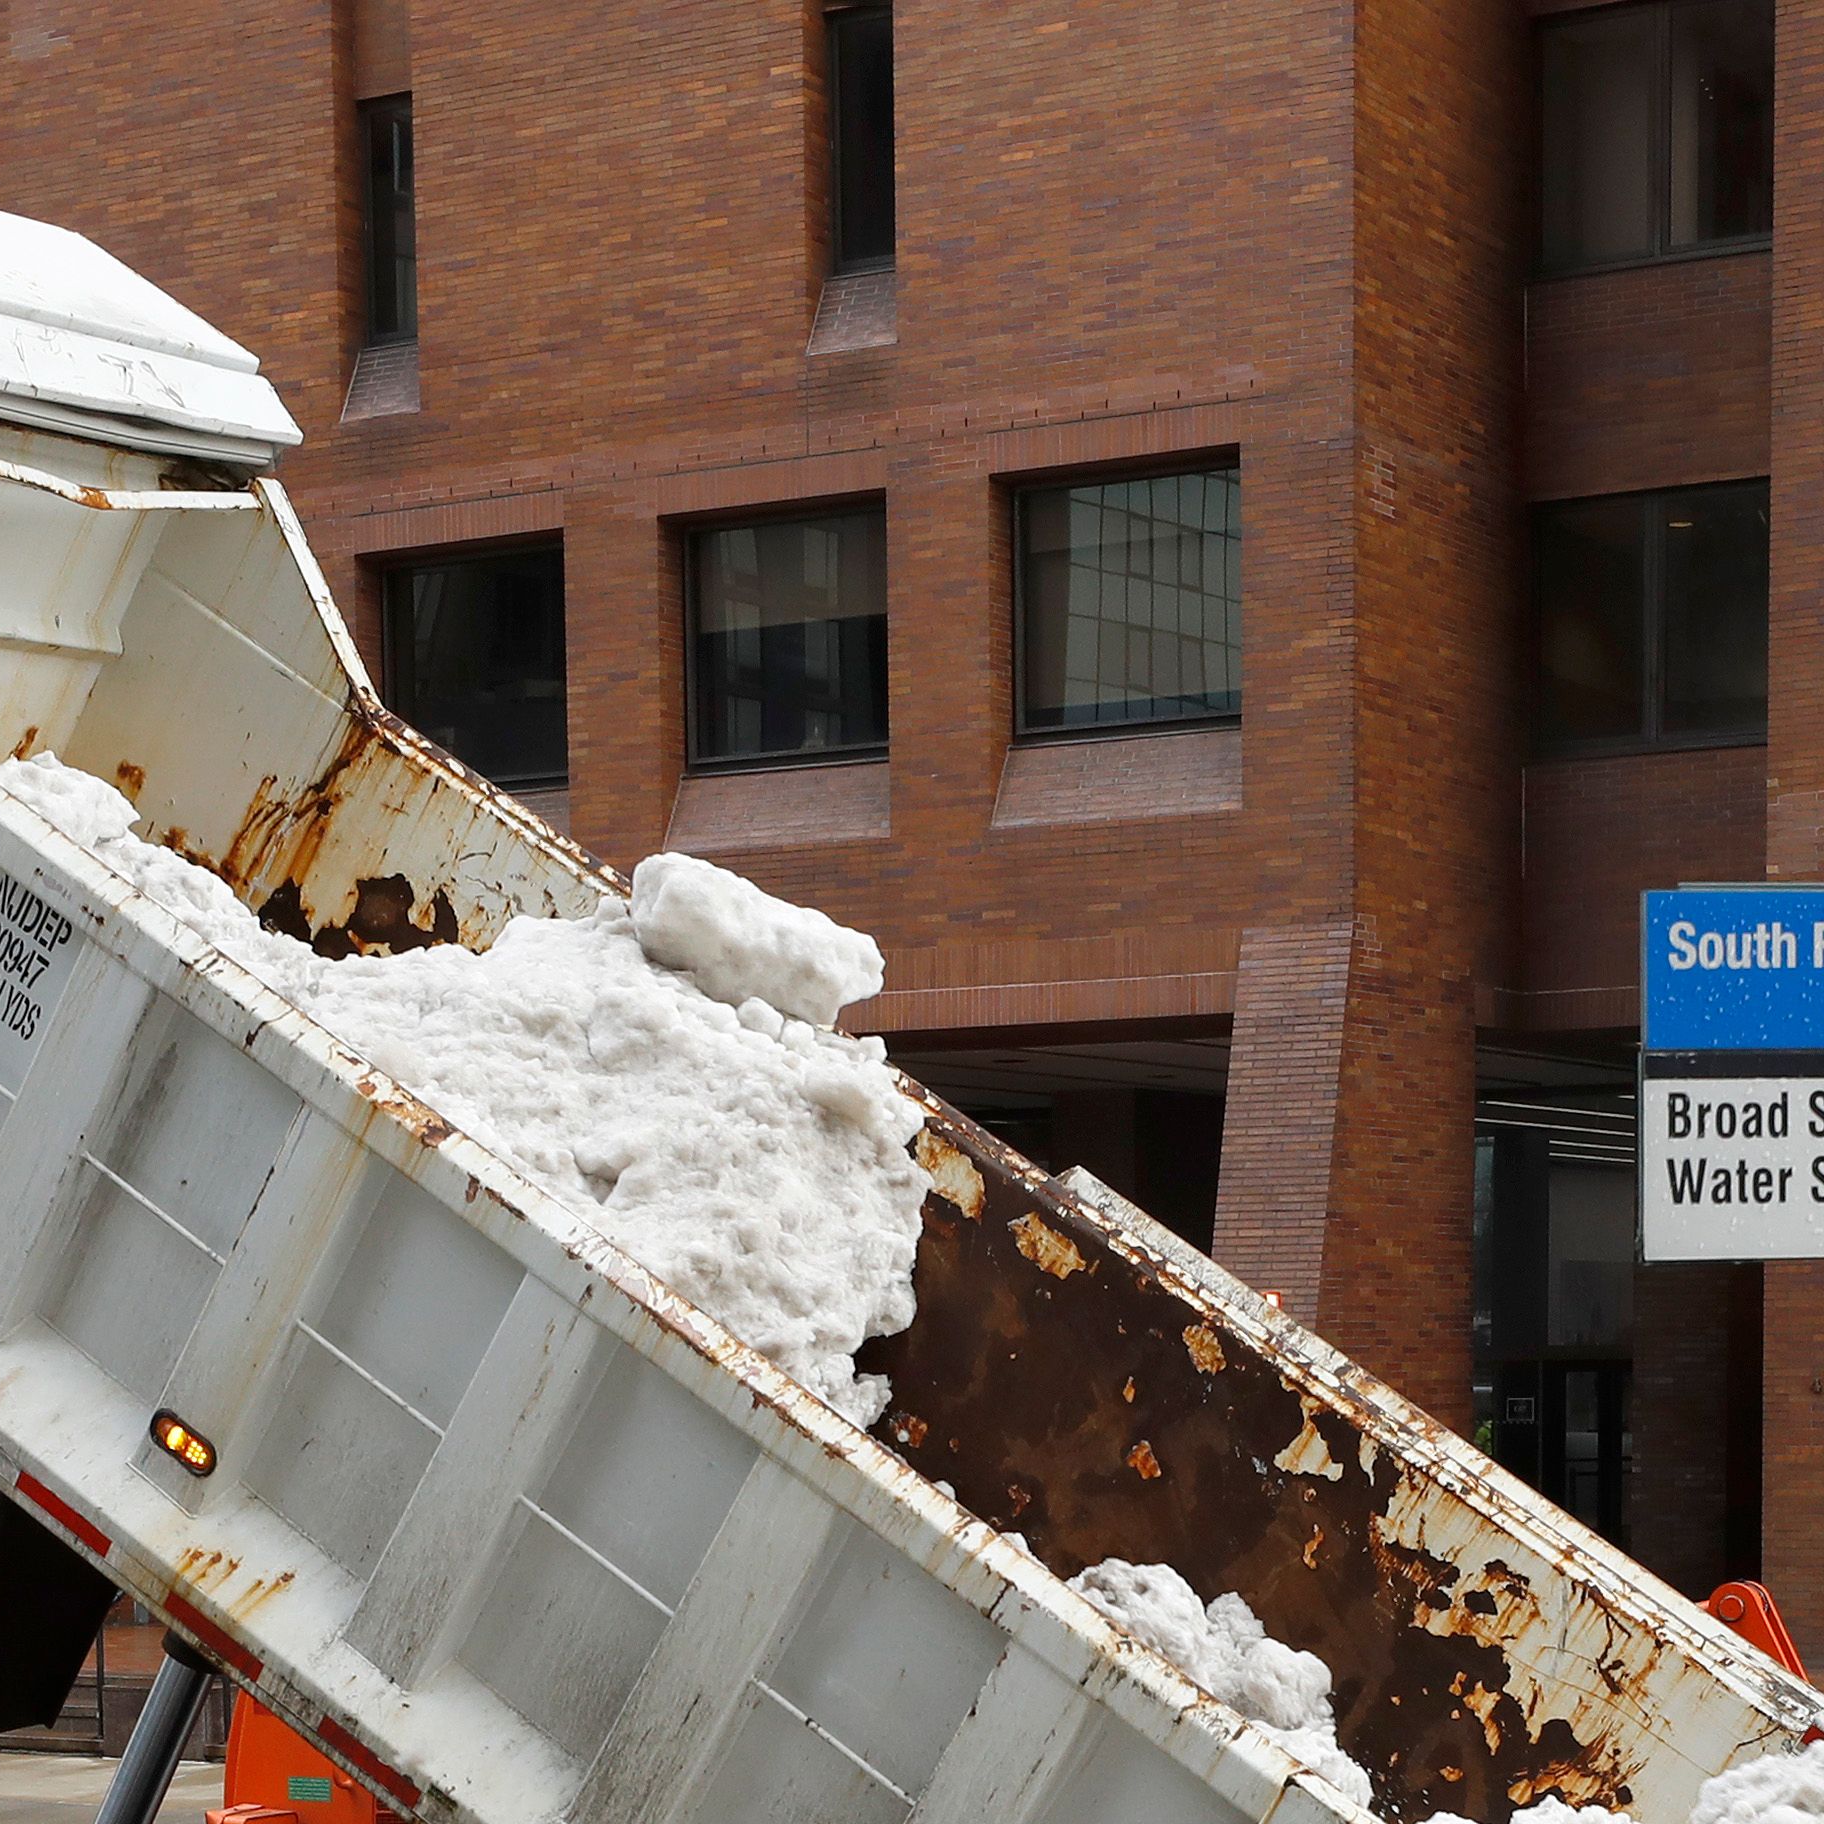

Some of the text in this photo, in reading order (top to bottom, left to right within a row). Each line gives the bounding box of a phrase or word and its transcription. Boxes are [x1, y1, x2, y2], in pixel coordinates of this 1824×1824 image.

[1668, 921, 1797, 970] South
[1, 986, 44, 1041] YDS
[1668, 1091, 1789, 1138] Broad
[1666, 1157, 1792, 1204] Water
